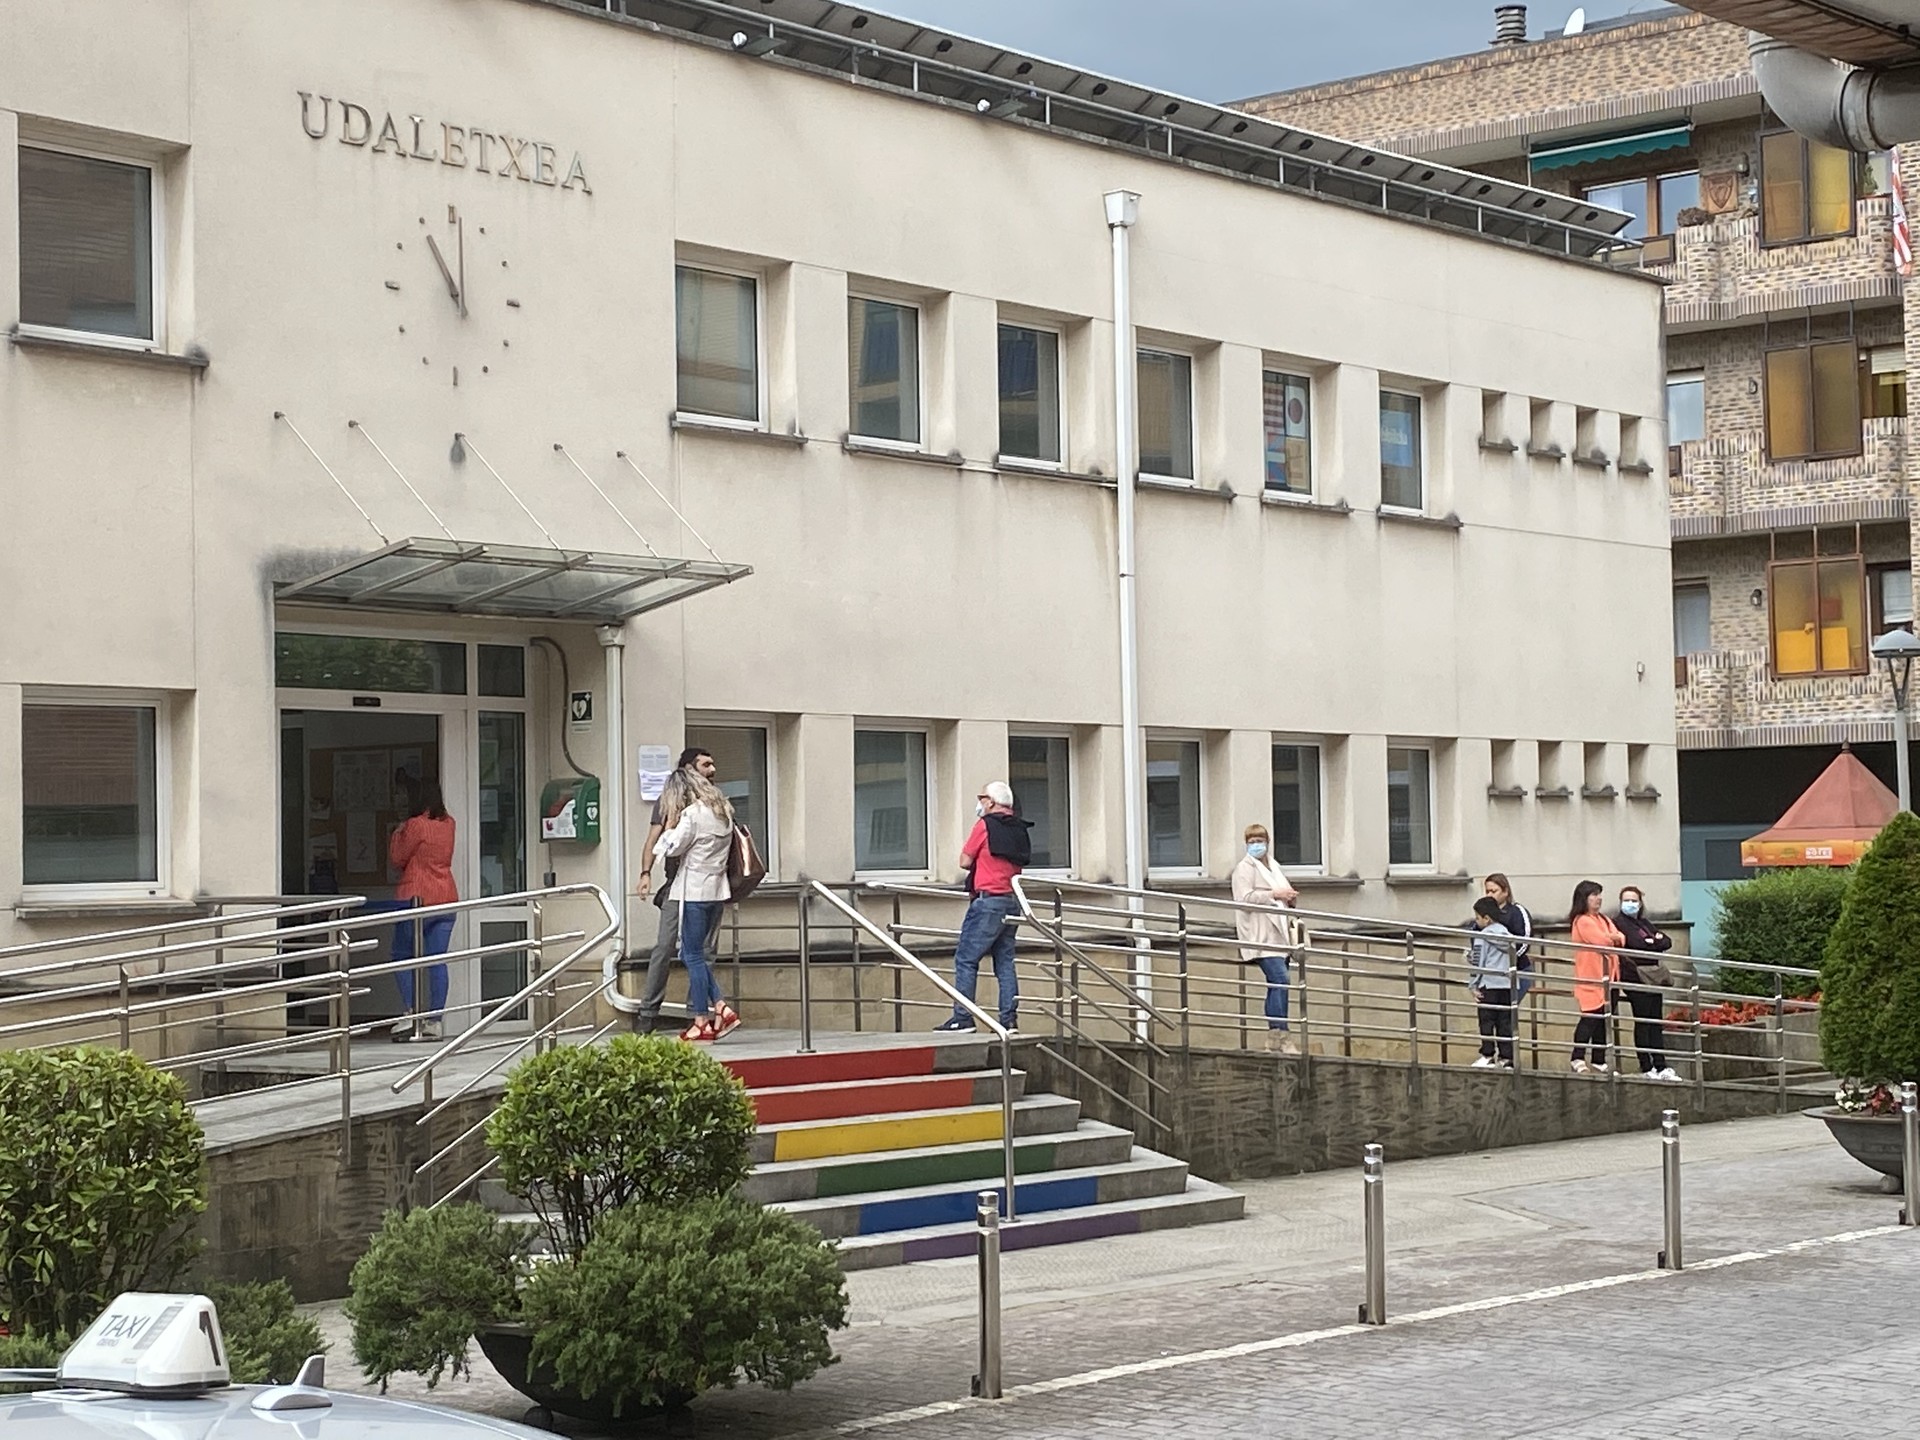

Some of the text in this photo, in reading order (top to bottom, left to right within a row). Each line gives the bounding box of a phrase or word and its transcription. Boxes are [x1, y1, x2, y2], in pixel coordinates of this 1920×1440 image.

[297, 91, 592, 195] UDALETXEA
[99, 1315, 150, 1338] TAXI
[199, 1311, 221, 1366] 1
